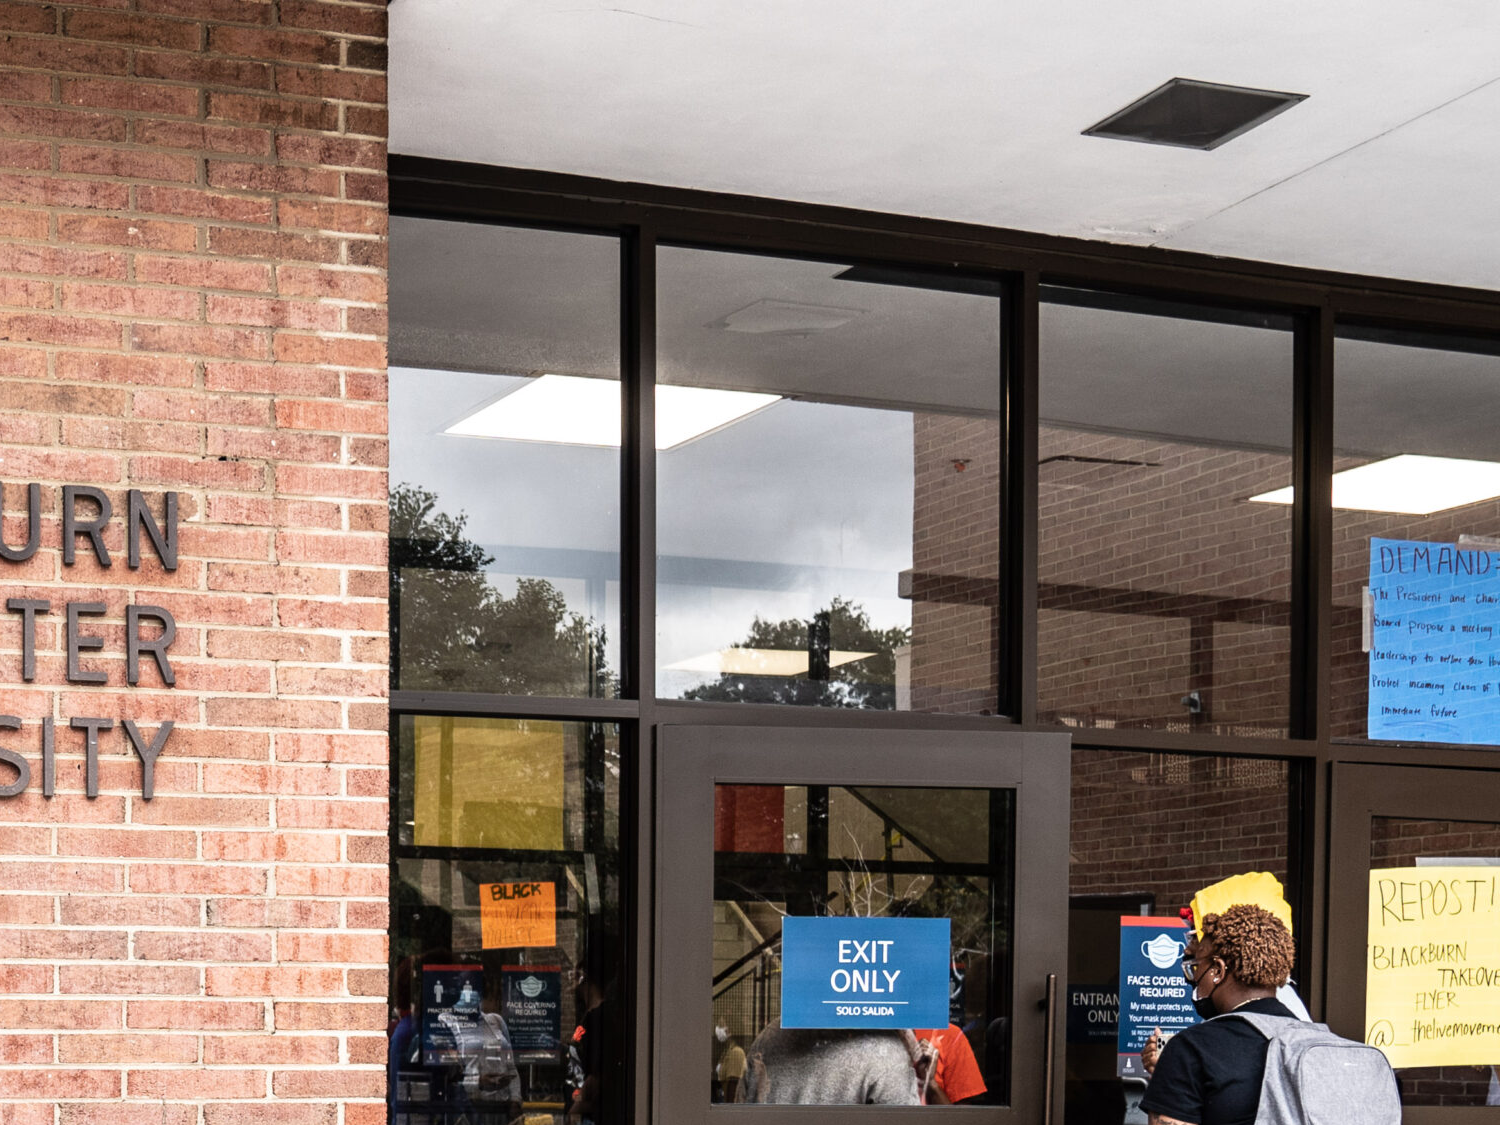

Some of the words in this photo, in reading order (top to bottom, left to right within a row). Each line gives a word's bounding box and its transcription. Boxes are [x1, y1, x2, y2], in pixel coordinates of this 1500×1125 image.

[490, 883, 542, 902] BLACK
[838, 940, 894, 964] EXIT
[1373, 941, 1468, 970] BLACKBURN
[830, 969, 901, 993] ONLY
[1127, 975, 1151, 986] FACE
[1152, 976, 1188, 987] COVERI
[1073, 992, 1120, 1006] ENTRAN
[1140, 987, 1186, 998] REQUIRED
[1415, 989, 1460, 1011] FLYER
[836, 1006, 860, 1016] SOLO
[862, 1007, 894, 1016] SALIDA
[1130, 1002, 1140, 1012] My
[1157, 1003, 1181, 1012] protects
[1088, 1010, 1120, 1023] ONLY
[1129, 1014, 1142, 1022] Your
[1160, 1016, 1184, 1024] protects
